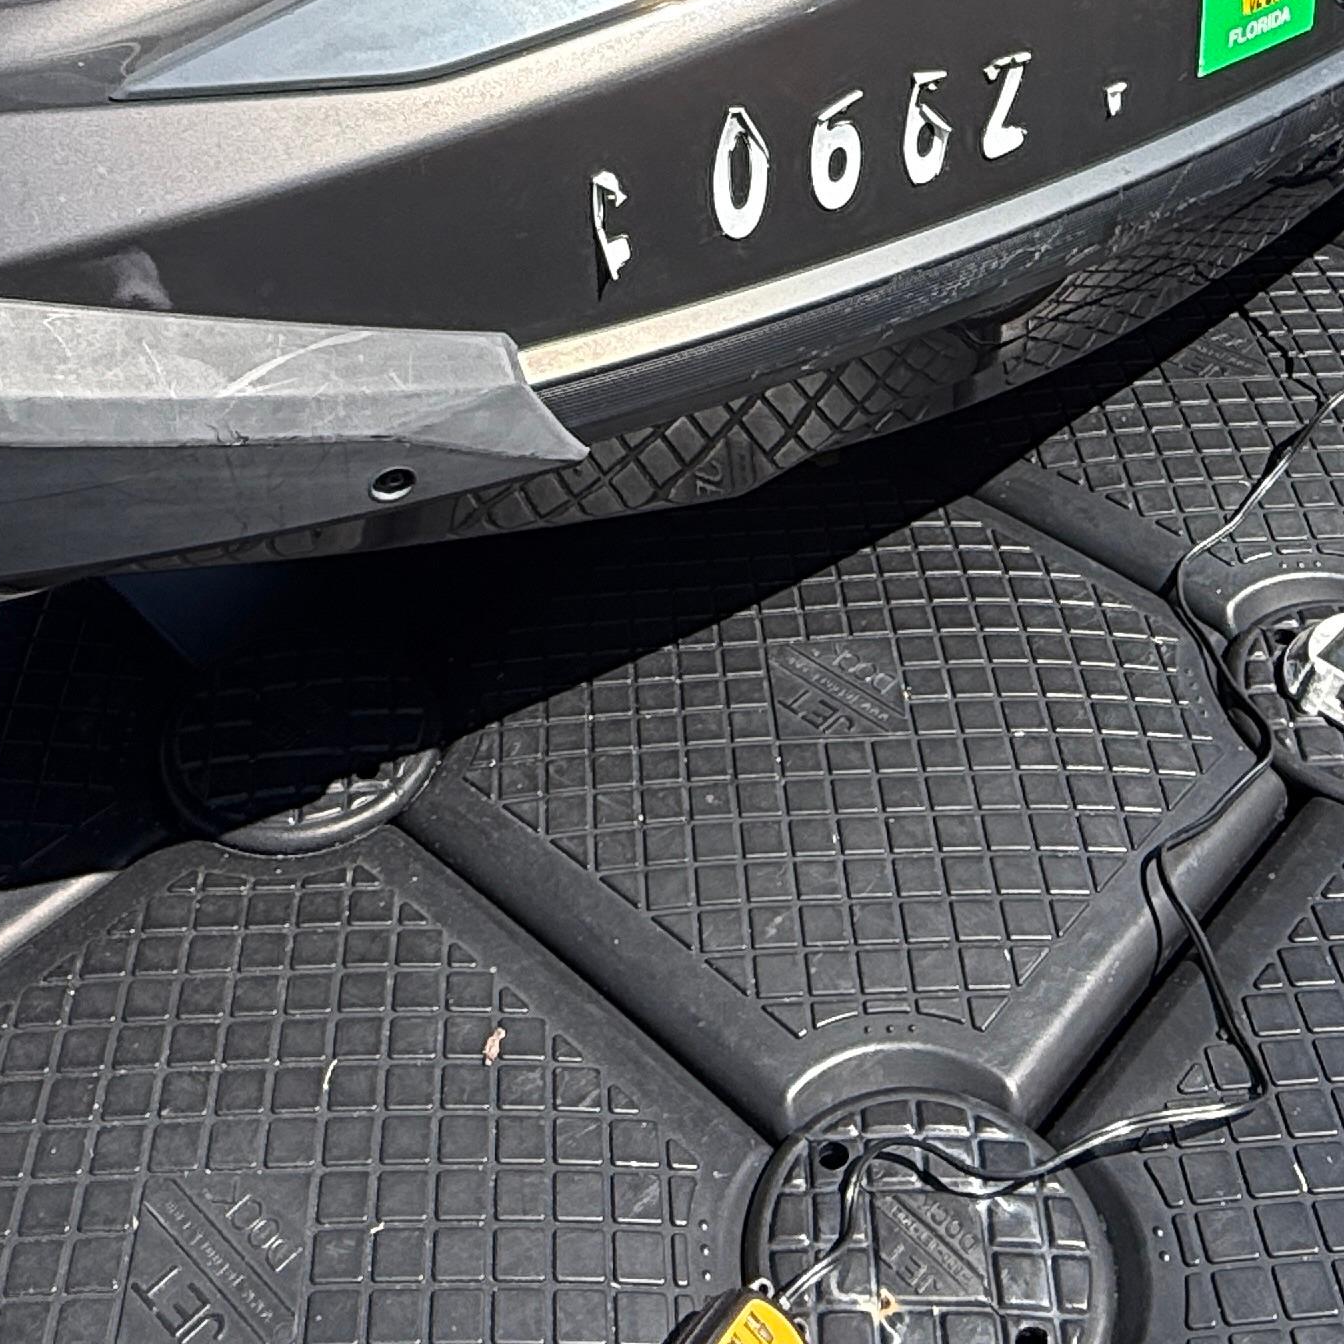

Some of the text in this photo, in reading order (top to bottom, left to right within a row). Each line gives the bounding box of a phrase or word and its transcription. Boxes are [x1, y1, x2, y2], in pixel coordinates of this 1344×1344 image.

[1228, 6, 1291, 48] FLORIDA
[777, 690, 855, 734] JET
[210, 1176, 303, 1272] DOCK
[131, 1265, 226, 1344] JET
